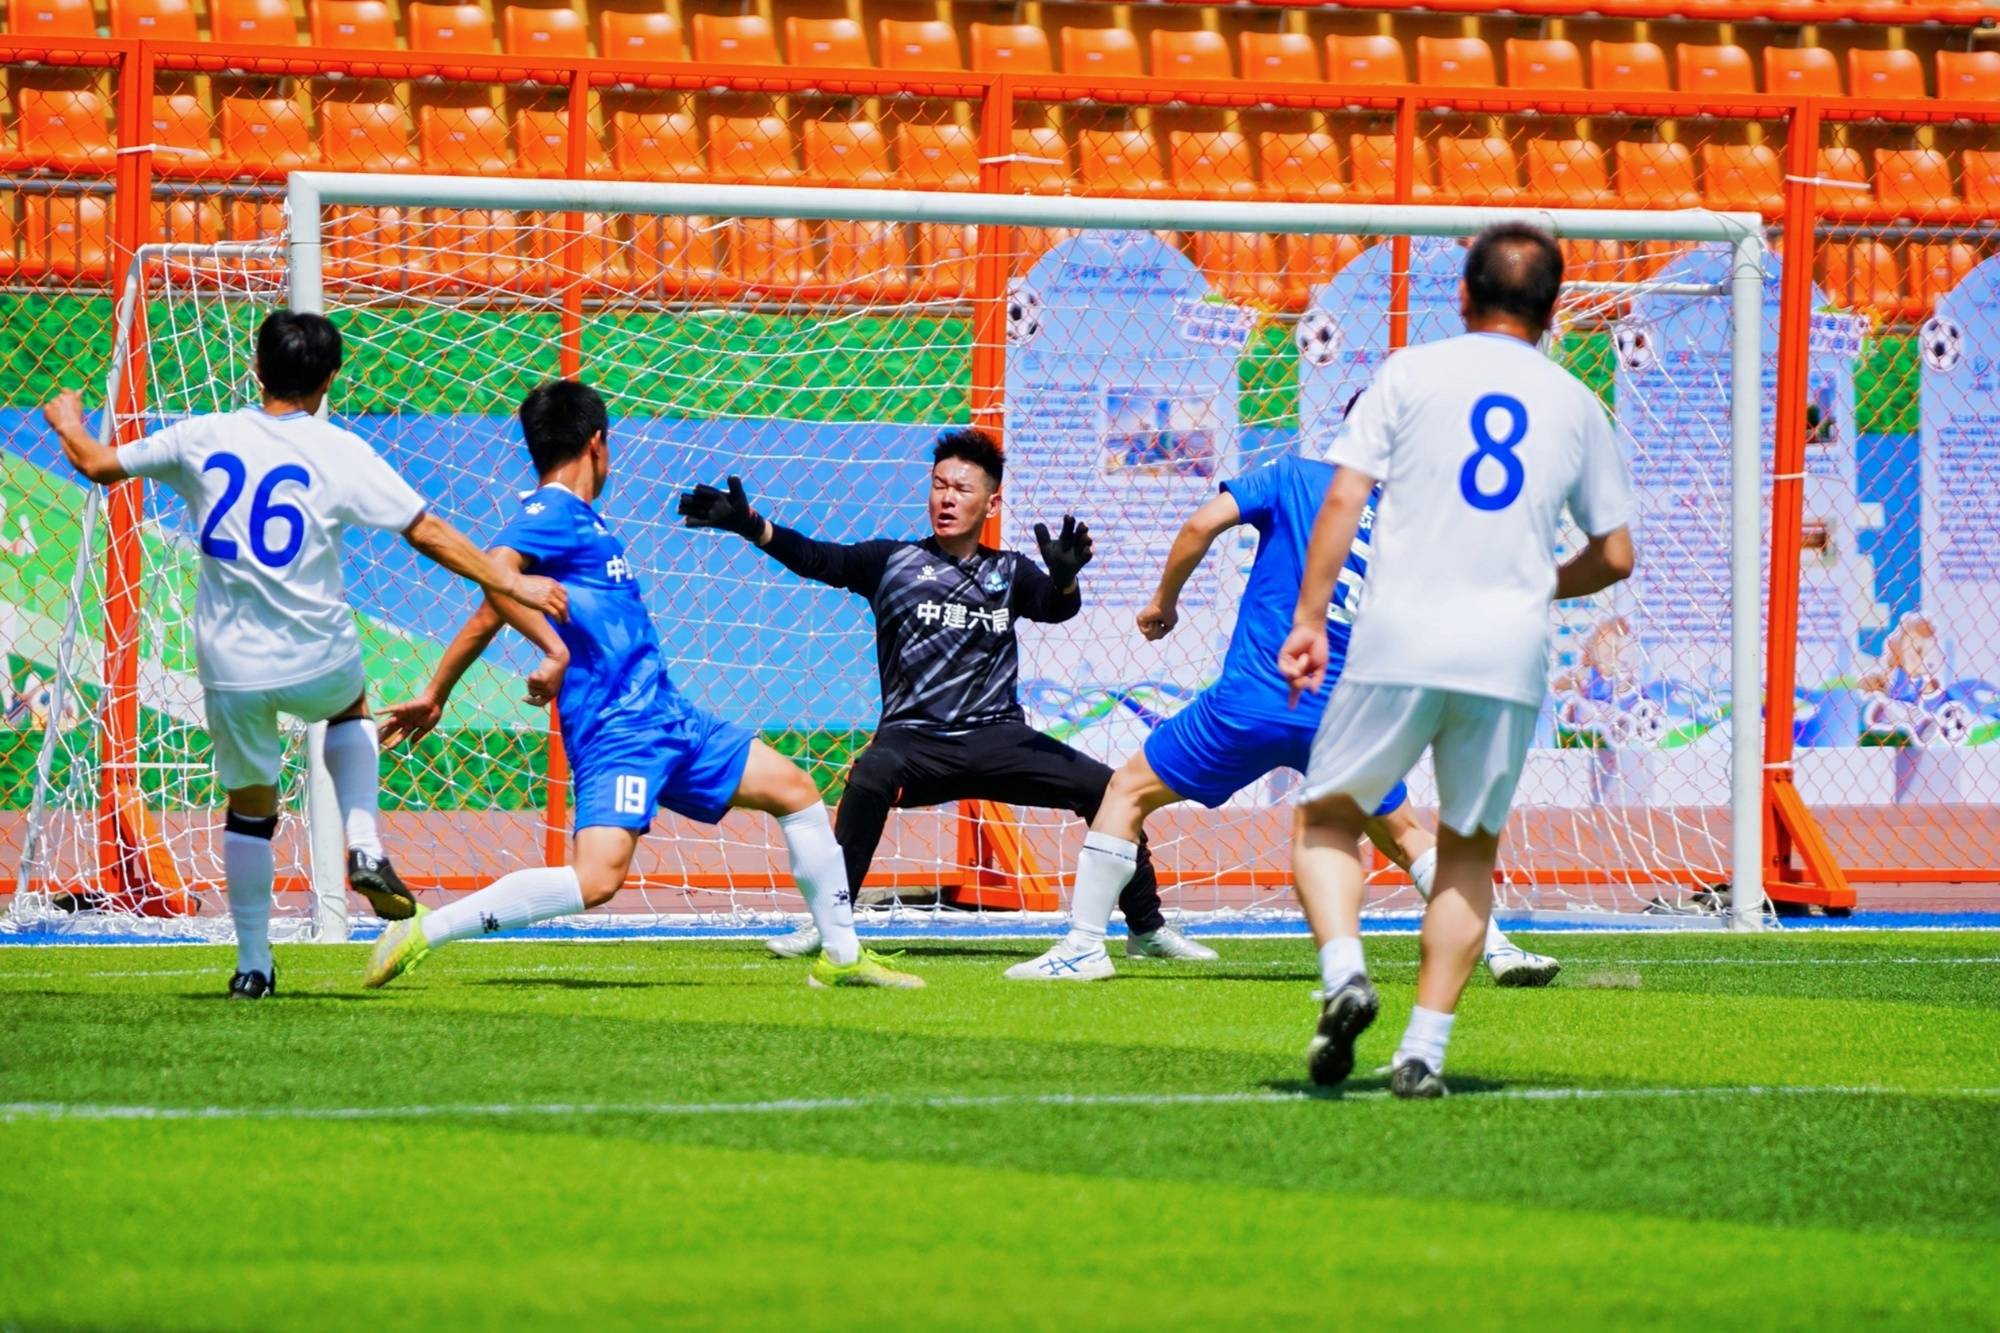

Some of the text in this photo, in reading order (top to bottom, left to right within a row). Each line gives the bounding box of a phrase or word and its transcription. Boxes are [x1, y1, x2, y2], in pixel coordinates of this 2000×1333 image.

[1460, 393, 1529, 511] 8
[201, 451, 310, 568] 26
[917, 600, 1009, 633] 中建六局
[615, 774, 647, 814] 19
